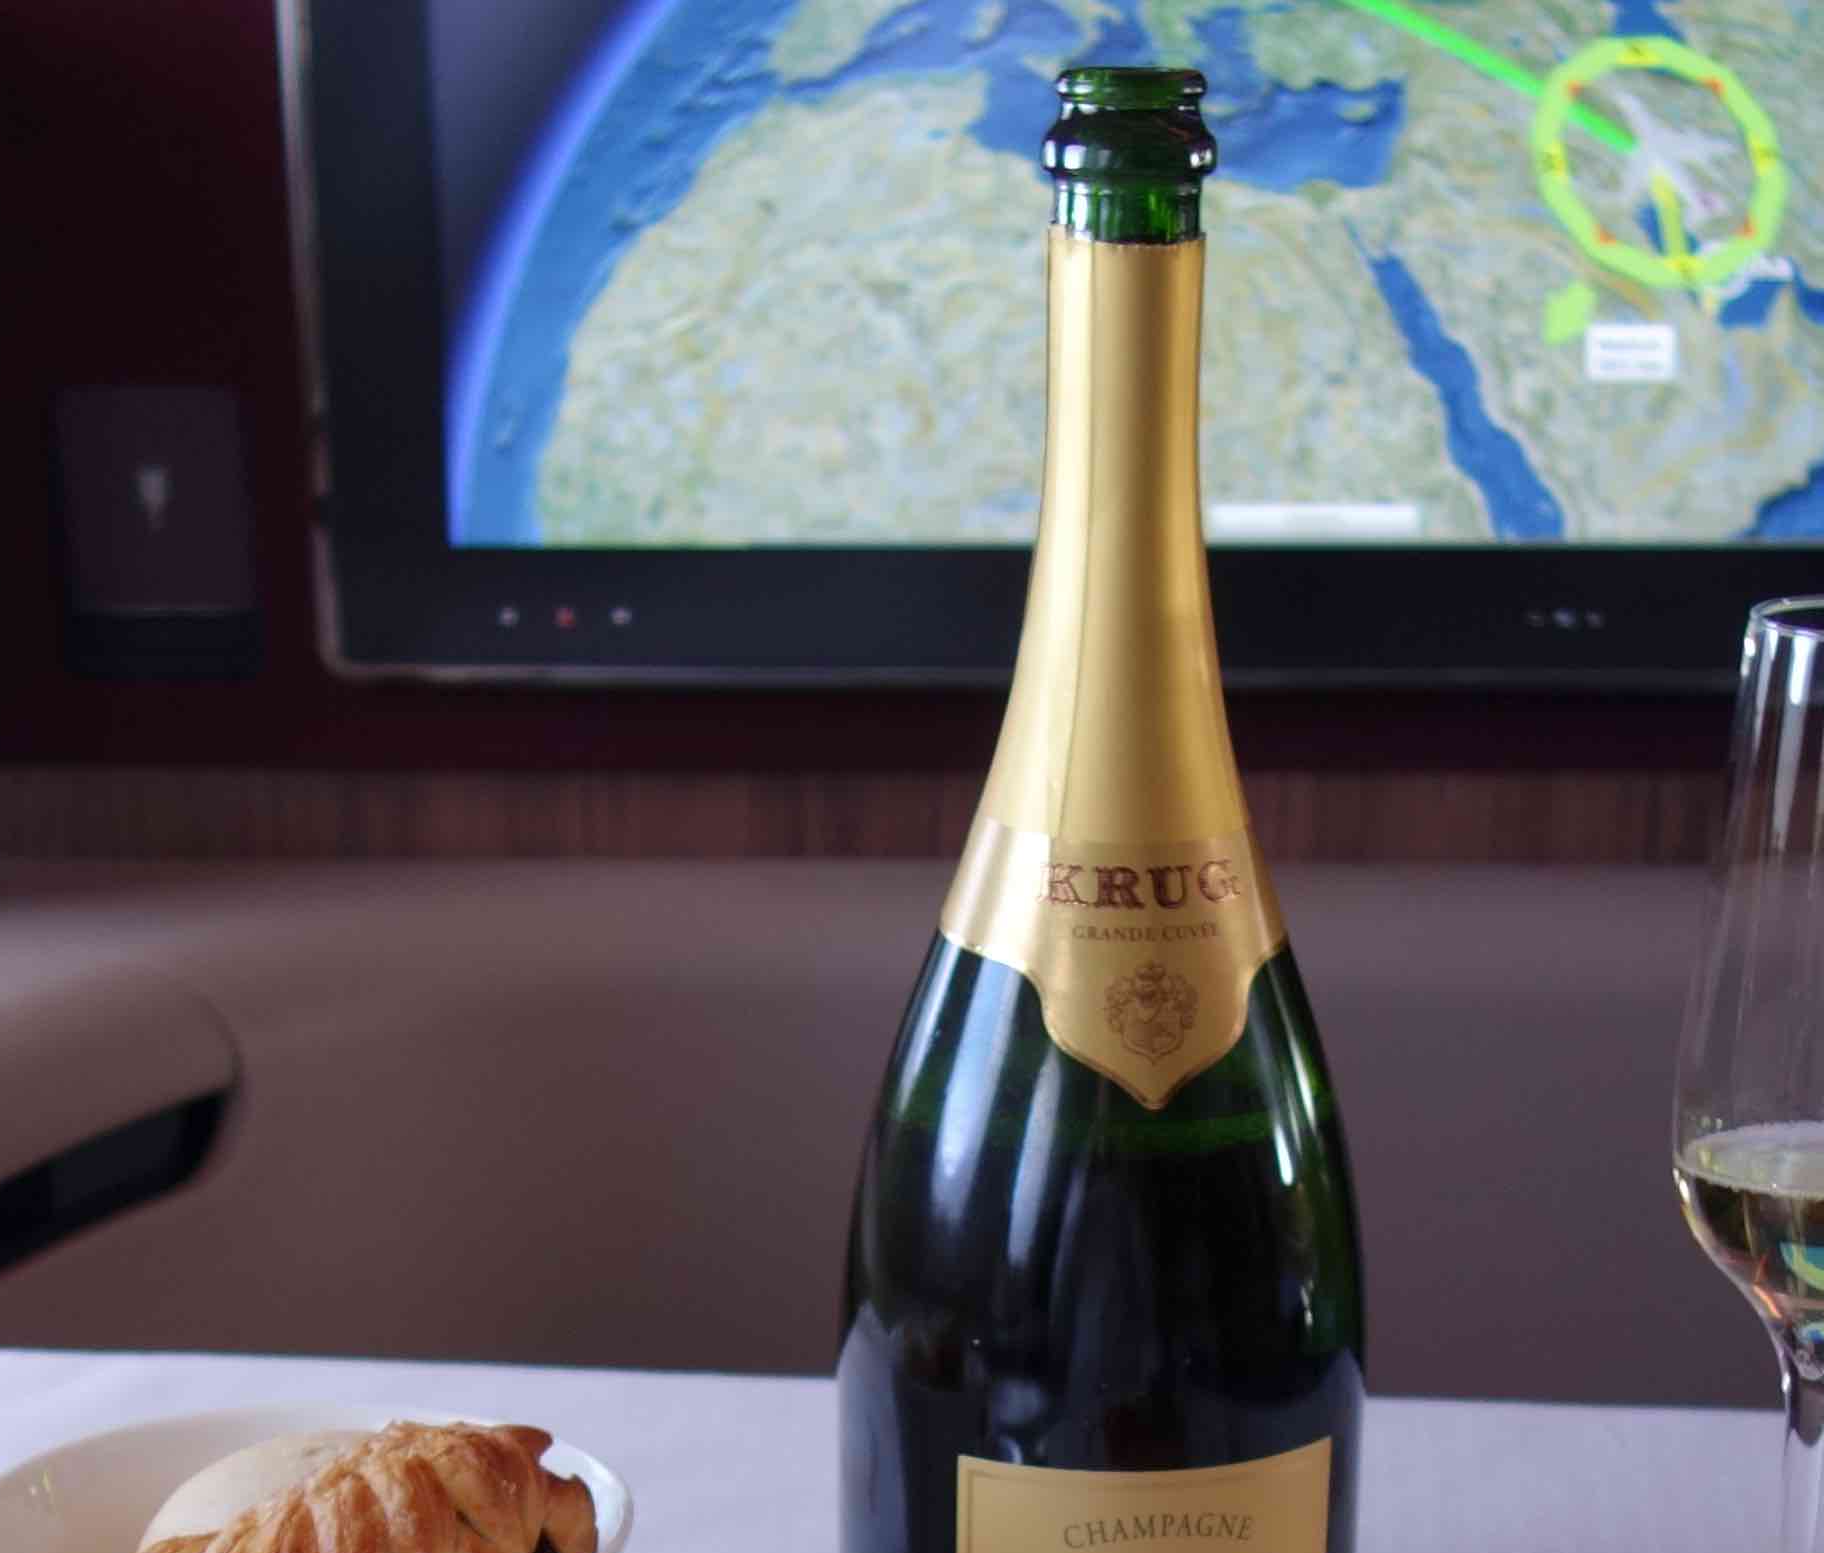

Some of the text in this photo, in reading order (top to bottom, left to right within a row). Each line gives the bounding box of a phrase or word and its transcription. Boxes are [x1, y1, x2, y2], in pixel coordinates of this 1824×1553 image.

[1038, 858, 1241, 909] KRUG
[1072, 924, 1156, 943] GRANDE
[1063, 1511, 1255, 1550] CHAMPAGNE
